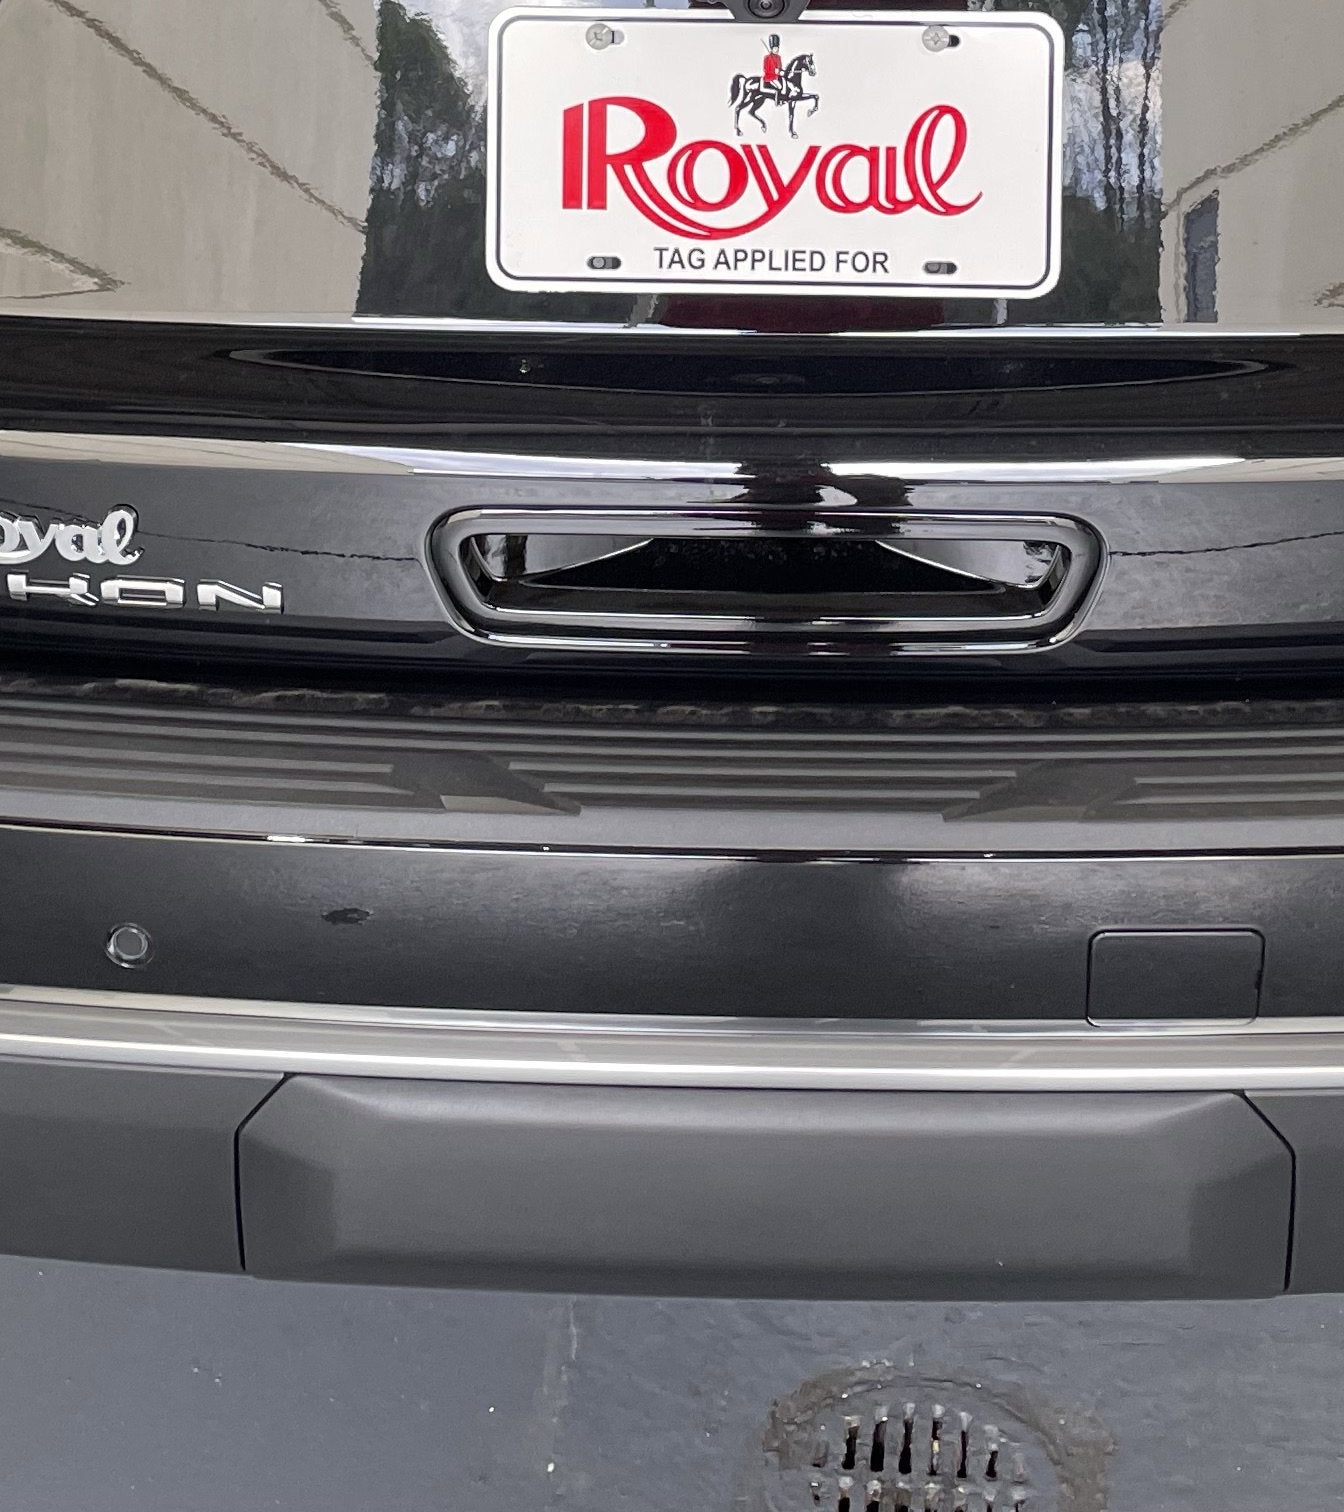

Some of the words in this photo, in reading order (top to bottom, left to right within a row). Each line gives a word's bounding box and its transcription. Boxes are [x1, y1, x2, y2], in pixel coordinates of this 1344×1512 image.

[561, 95, 984, 240] Royal
[654, 247, 706, 270] TAG
[713, 248, 826, 272] APPLIED
[835, 250, 890, 273] FOR
